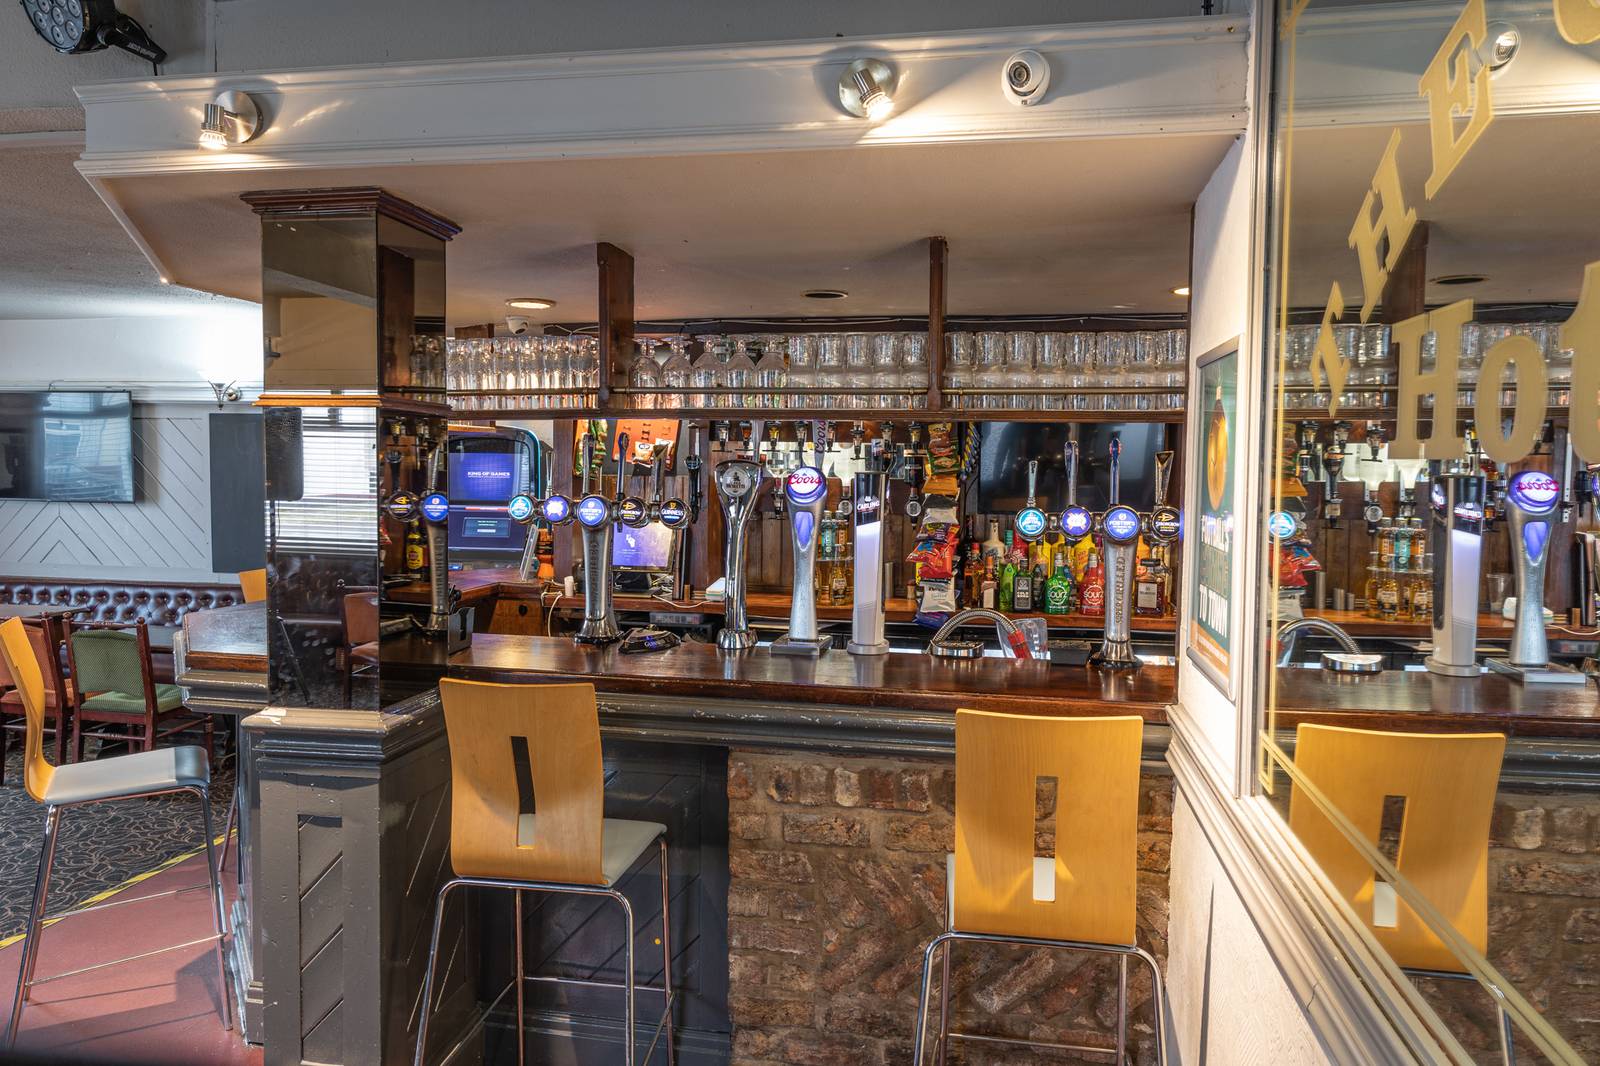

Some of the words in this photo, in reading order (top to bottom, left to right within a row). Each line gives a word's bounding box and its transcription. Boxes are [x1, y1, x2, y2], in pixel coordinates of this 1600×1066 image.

[787, 473, 823, 486] Coors
[856, 500, 881, 511] CARLING
[661, 508, 684, 516] GUINNESS
